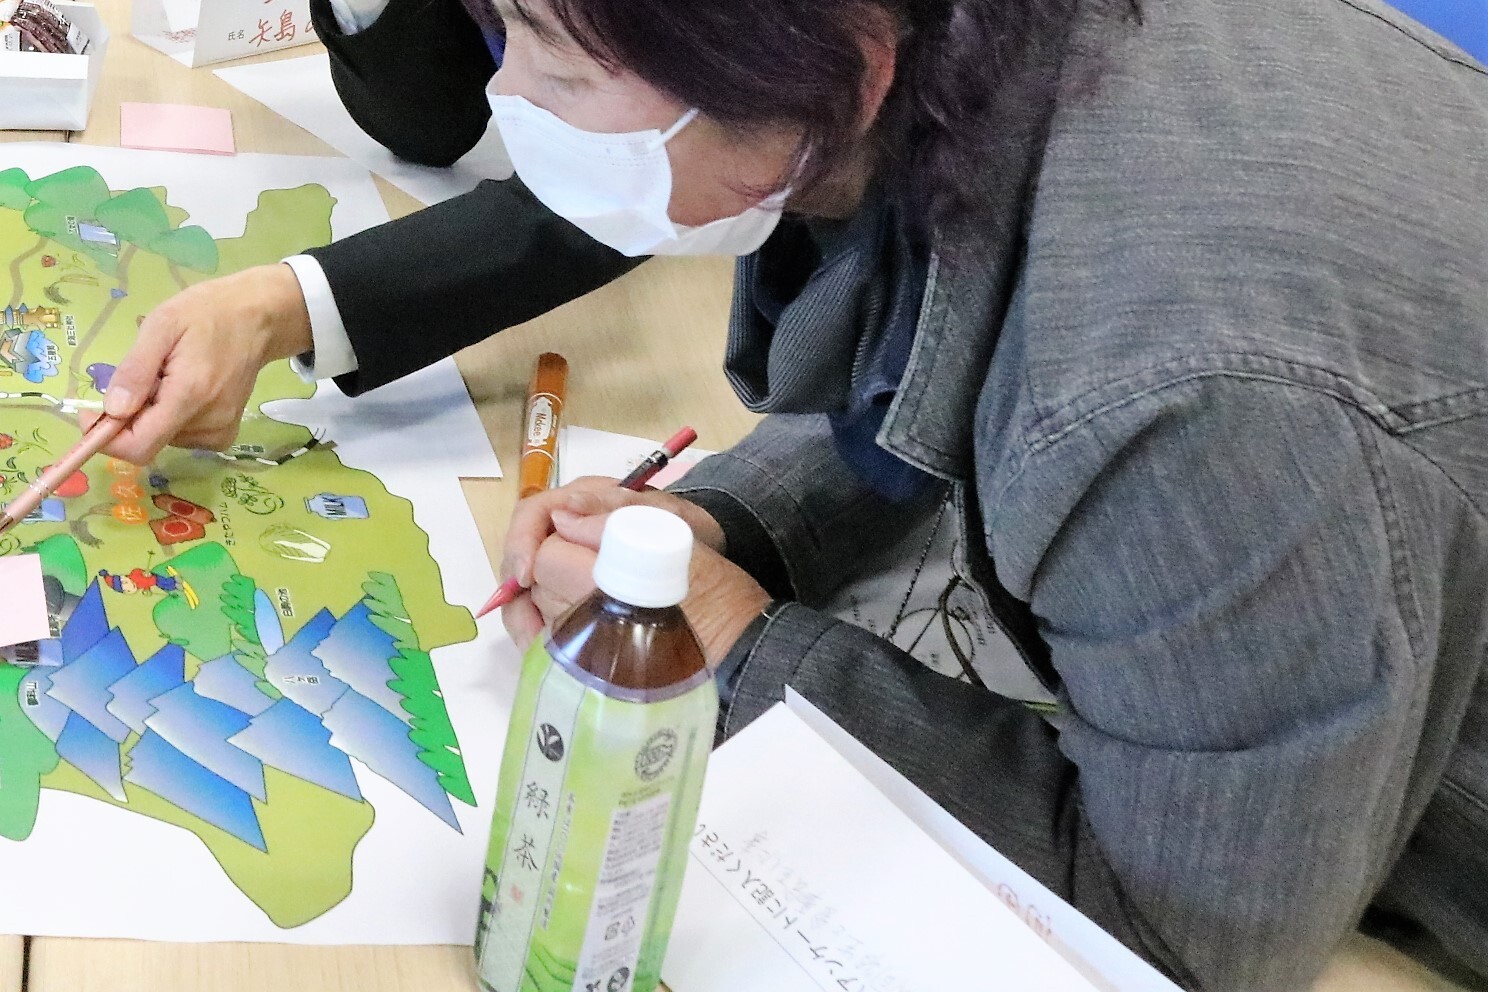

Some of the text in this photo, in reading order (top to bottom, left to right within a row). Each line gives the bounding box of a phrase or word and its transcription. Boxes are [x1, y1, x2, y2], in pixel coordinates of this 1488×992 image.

[227, 29, 245, 42] 氏名
[322, 496, 347, 517] MILK
[513, 780, 552, 875] 緑茶
